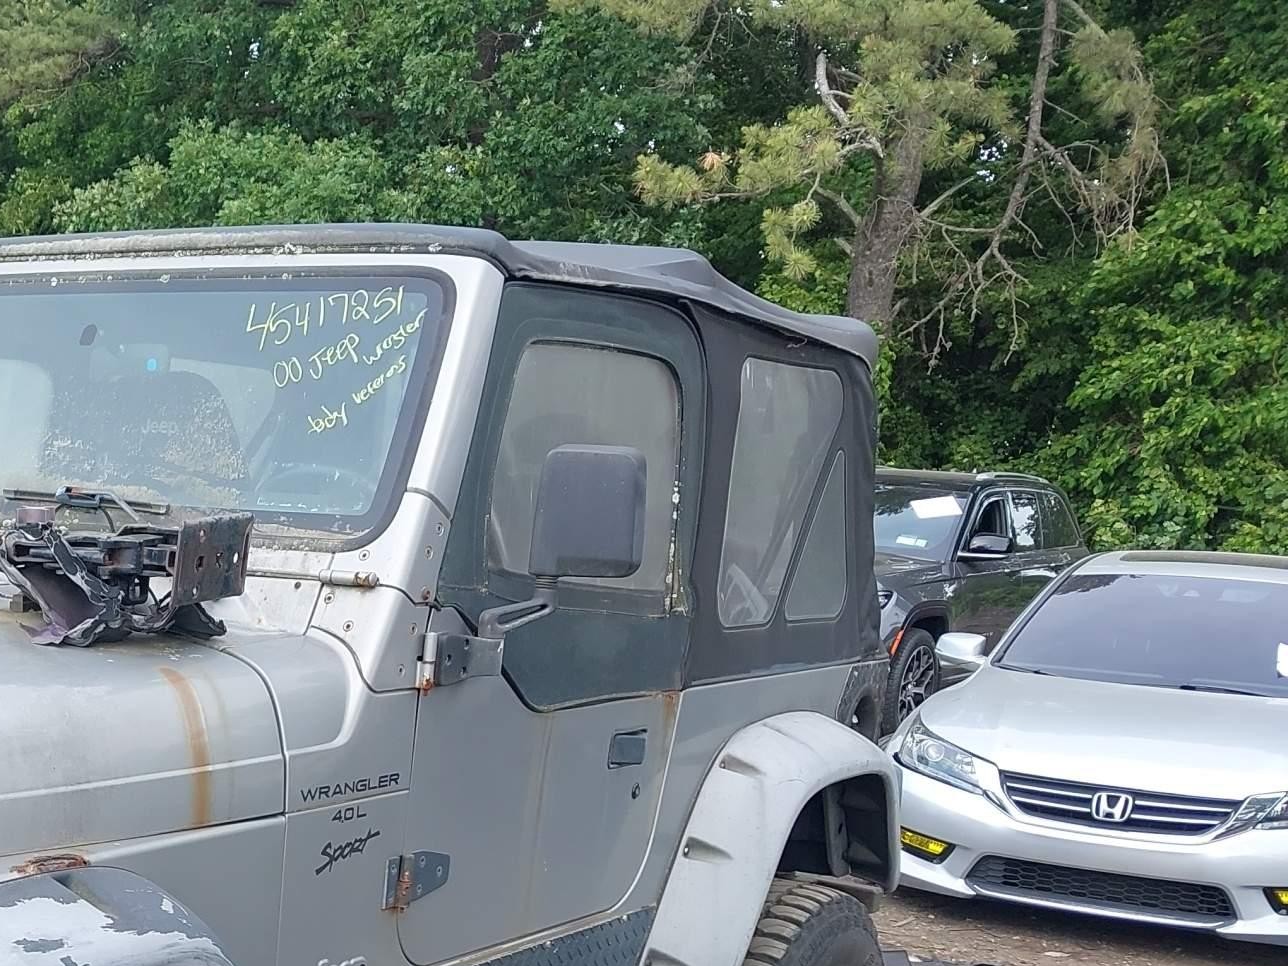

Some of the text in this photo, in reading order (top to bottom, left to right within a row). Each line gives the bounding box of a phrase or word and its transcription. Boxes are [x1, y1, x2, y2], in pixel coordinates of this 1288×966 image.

[245, 285, 406, 352] 45417251
[273, 357, 303, 388] 00
[308, 332, 360, 380] Jeep
[300, 772, 401, 802] WRANGLER
[315, 828, 381, 876] Sport
